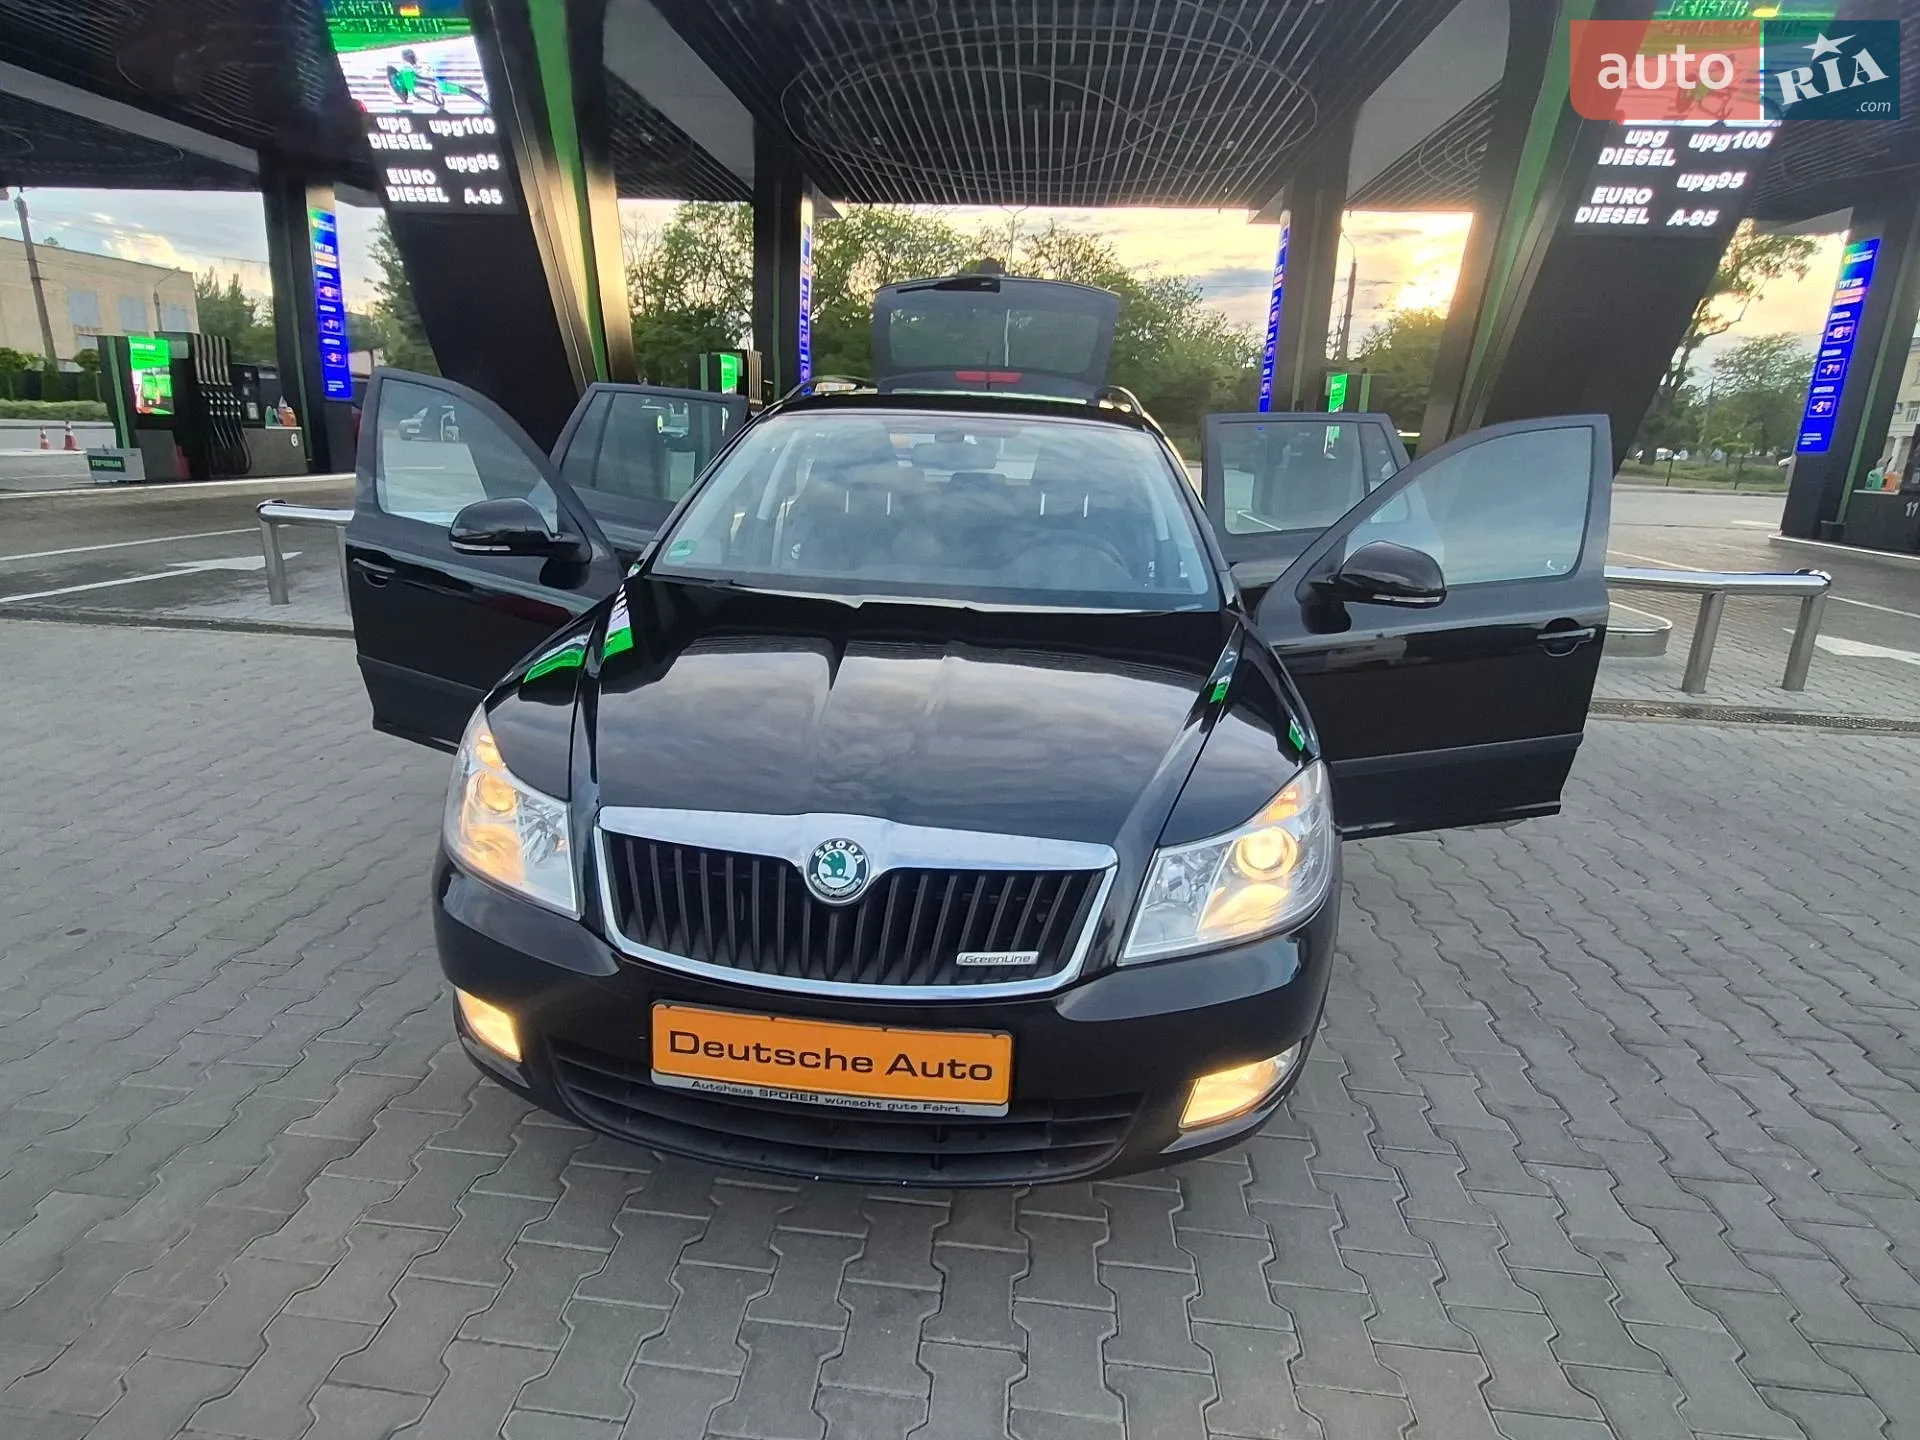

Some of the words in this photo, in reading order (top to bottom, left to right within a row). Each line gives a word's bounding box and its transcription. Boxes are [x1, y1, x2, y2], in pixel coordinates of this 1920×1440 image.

[376, 117, 412, 134] upg
[428, 117, 497, 137] upg100
[367, 132, 433, 150] DIESEL
[1624, 129, 1669, 148] upg
[1688, 131, 1775, 152] upg100
[444, 154, 500, 173] upg95
[1598, 147, 1677, 167] DIESEL
[386, 168, 437, 185] EURO
[1676, 171, 1747, 192] upg95
[385, 185, 450, 203] DIESEL
[1591, 186, 1654, 205] EURO
[1574, 206, 1650, 225] DIESEL
[1665, 208, 1720, 227] A-95
[963, 955, 1032, 965] GreenLine
[669, 1030, 874, 1075] Deutsche
[885, 1053, 994, 1082] Auto
[691, 1080, 754, 1096] Autohaus
[758, 1088, 820, 1104] SPORER
[824, 1097, 882, 1110] wünscht
[887, 1102, 919, 1114] gute
